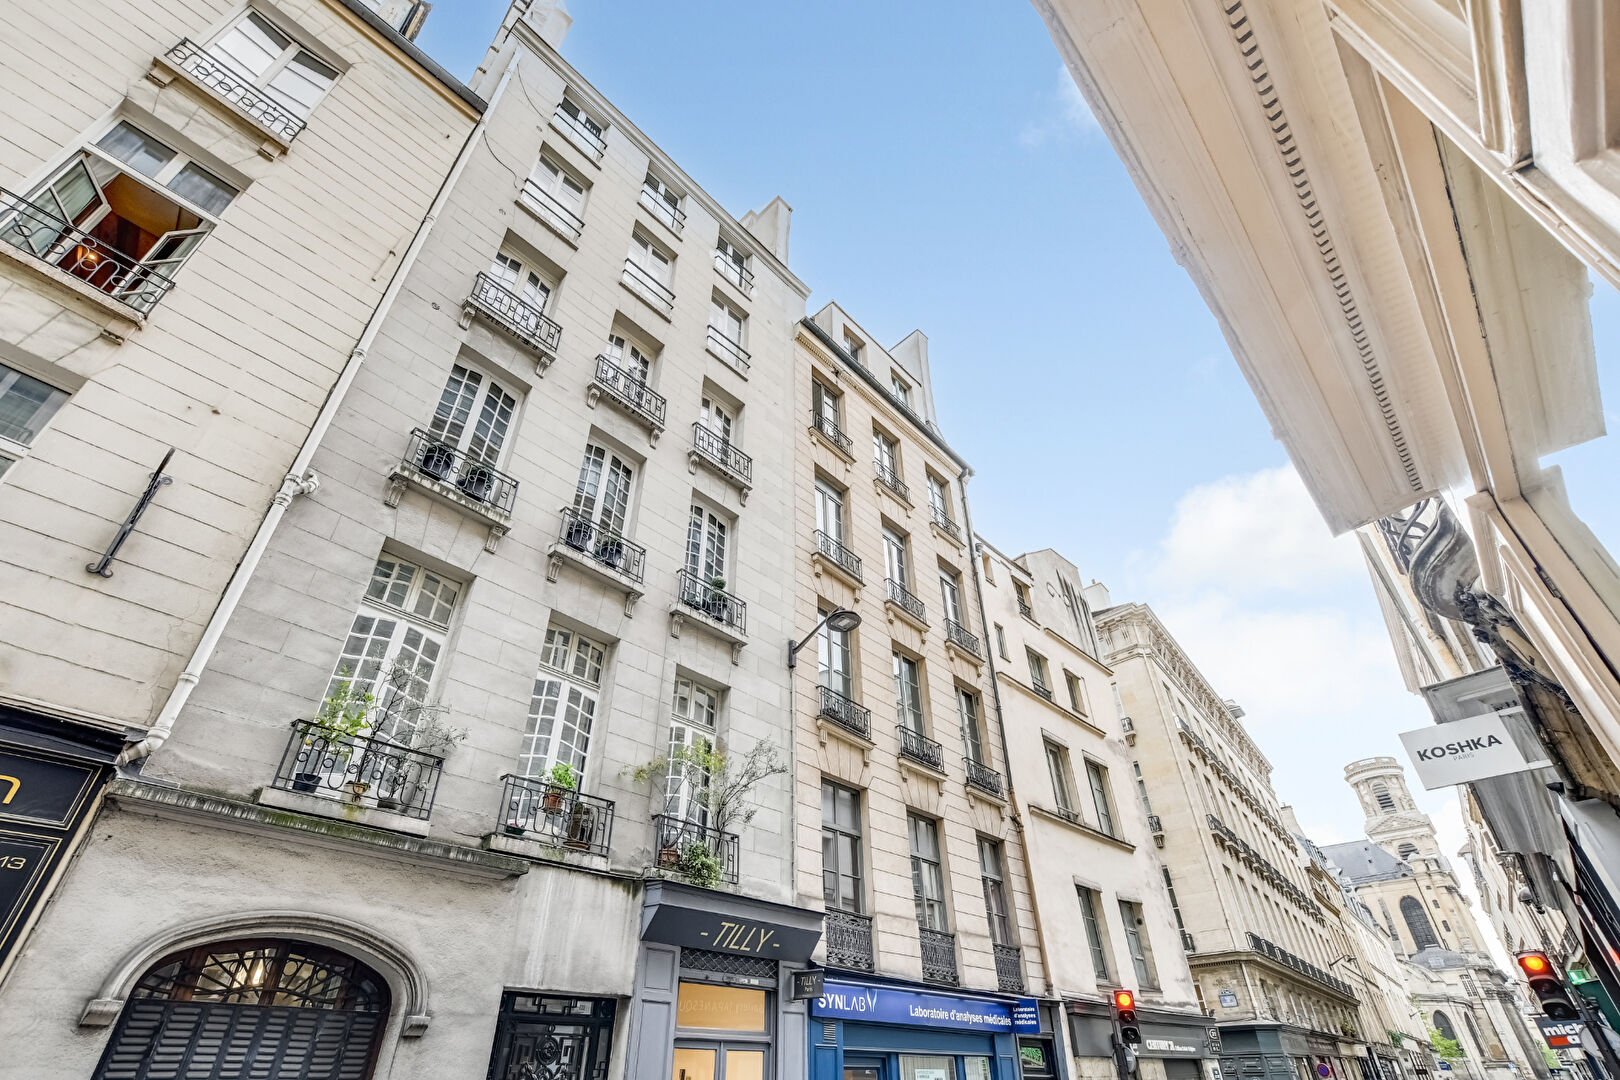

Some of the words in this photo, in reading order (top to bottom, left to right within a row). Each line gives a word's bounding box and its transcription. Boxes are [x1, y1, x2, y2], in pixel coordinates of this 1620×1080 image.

[1416, 734, 1503, 762] KOSHKA
[1453, 752, 1475, 761] PARIS
[713, 921, 774, 953] TILLY
[818, 992, 866, 1012] SYNLAB
[909, 1004, 949, 1020] Laboratoire
[950, 1010, 983, 1025] d'analyses
[983, 1012, 1012, 1026] médicales
[1543, 1023, 1583, 1036] micr
